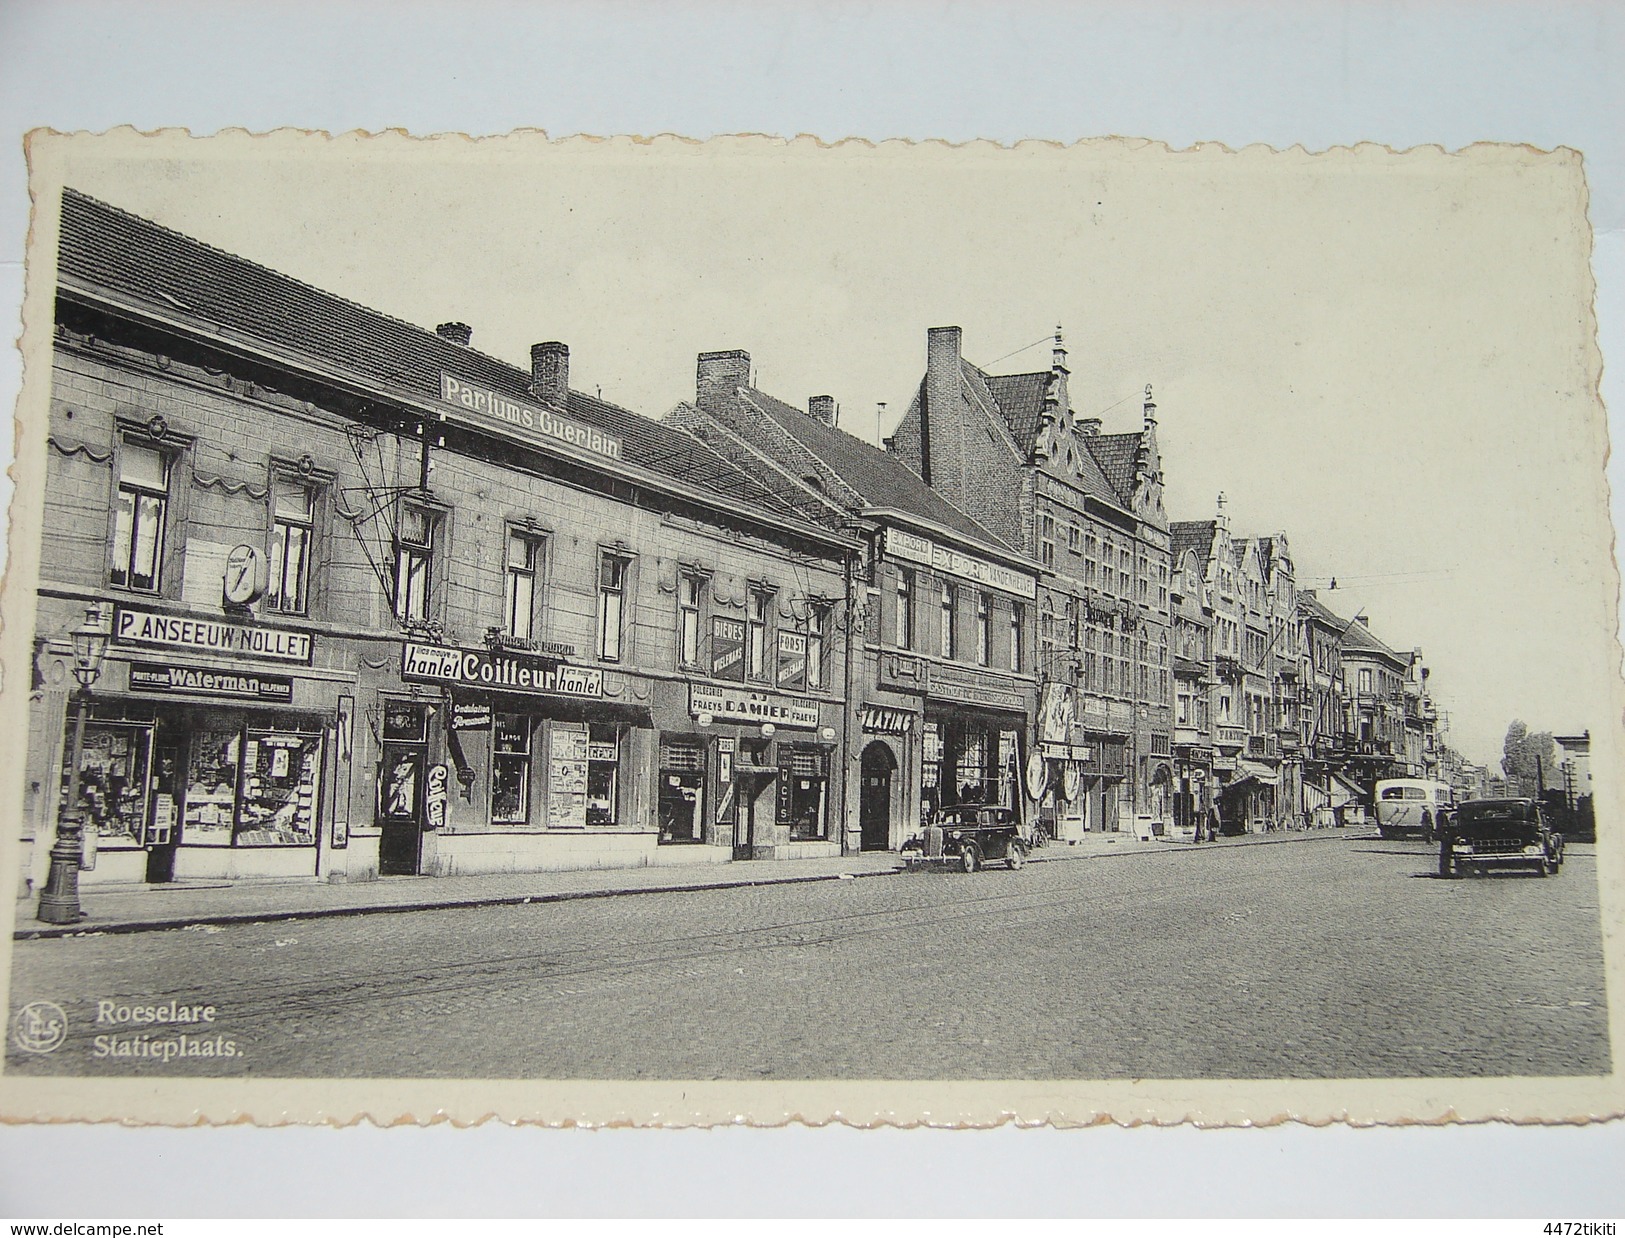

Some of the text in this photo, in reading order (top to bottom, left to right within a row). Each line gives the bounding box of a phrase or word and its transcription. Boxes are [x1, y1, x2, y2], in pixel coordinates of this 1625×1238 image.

[445, 375, 618, 457] Parfums Guerlain
[933, 548, 988, 582] EXPORT
[120, 613, 137, 636] P.
[169, 668, 259, 693] Waterman
[462, 654, 556, 689] Coiffeur
[692, 700, 723, 711] FRAEYS
[725, 700, 790, 718] DAMIER
